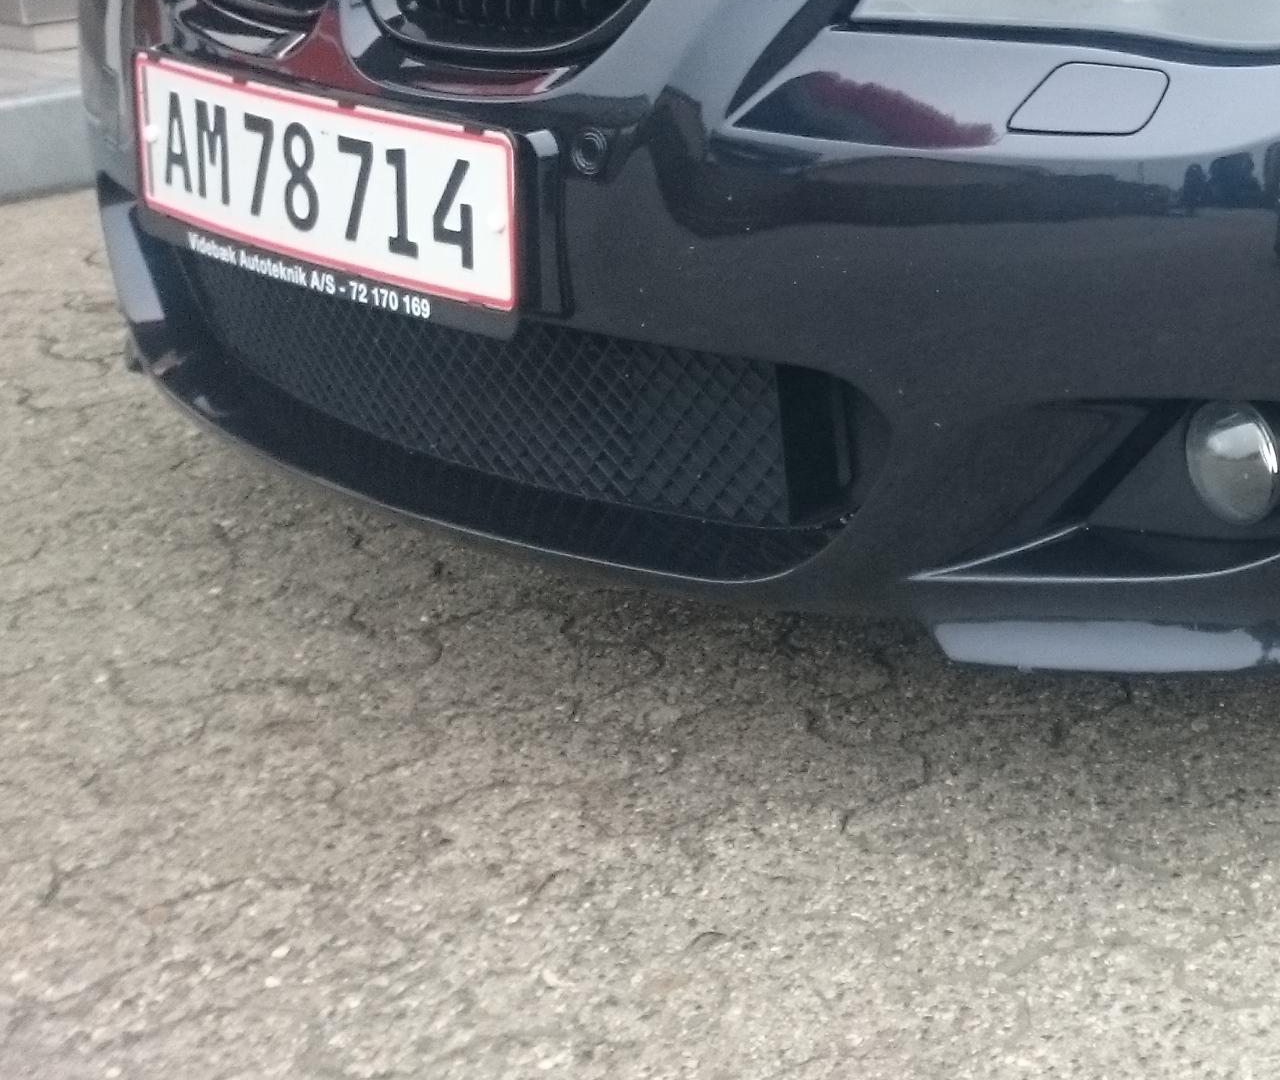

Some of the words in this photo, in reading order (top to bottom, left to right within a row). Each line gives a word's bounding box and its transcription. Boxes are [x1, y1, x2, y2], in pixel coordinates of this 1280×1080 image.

[165, 91, 230, 206] AM
[243, 112, 320, 232] 78
[337, 134, 475, 271] 714
[187, 231, 237, 266] Videbæk
[240, 249, 308, 287] Autoteknik
[310, 270, 336, 295] A/S
[349, 280, 368, 304] 72
[371, 287, 399, 312] 170
[402, 294, 431, 319] 169
